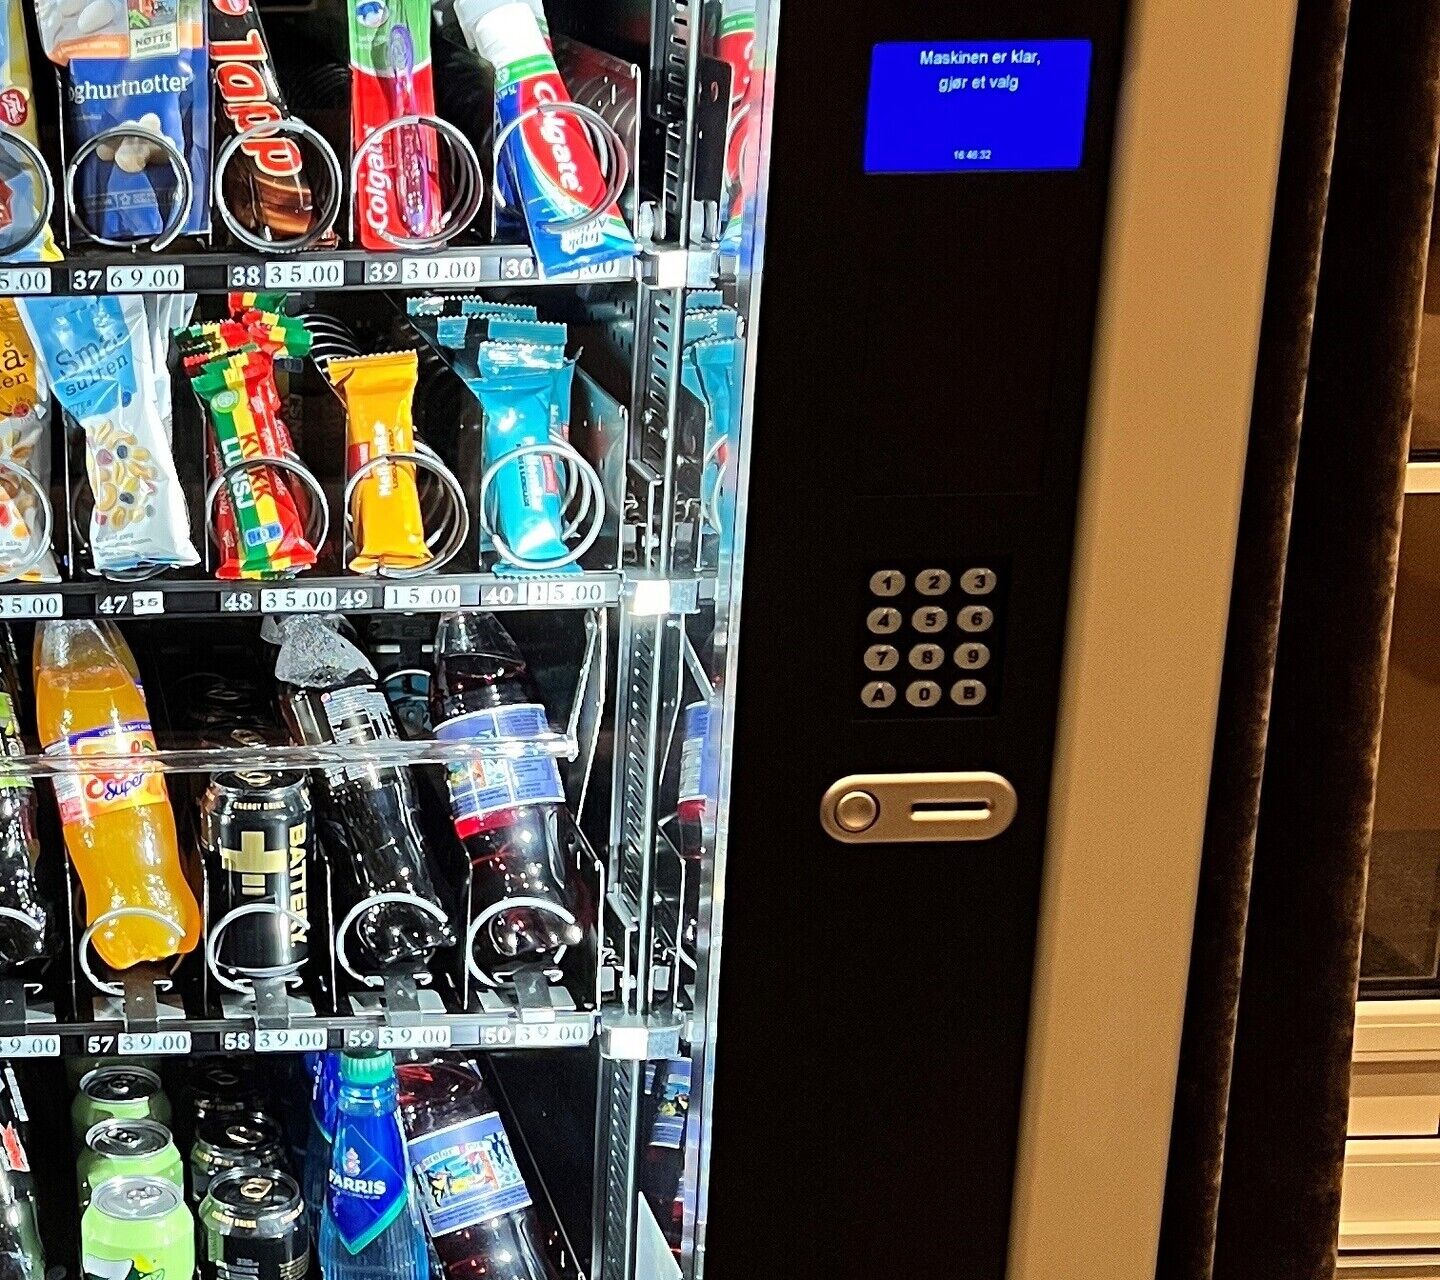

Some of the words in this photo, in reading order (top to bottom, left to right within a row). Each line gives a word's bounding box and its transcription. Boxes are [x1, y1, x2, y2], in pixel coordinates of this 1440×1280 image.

[920, 50, 989, 65] Maskinen
[992, 51, 1007, 64] er
[1011, 49, 1041, 66] klar,
[67, 72, 191, 104] oghurtnøtter
[939, 77, 968, 93] gjør
[971, 76, 986, 89] et
[989, 74, 1019, 92] valg
[232, 266, 261, 285] 38
[269, 264, 340, 283] 35.00
[369, 262, 398, 282] 39
[407, 262, 476, 280] 30.00
[505, 259, 534, 279] 30
[73, 270, 102, 290] 37
[110, 269, 180, 288] 69.00
[65, 354, 129, 396] sulten
[220, 436, 256, 510] LUNSJ
[882, 577, 892, 589] 1
[928, 576, 940, 589] 2
[974, 575, 986, 588] 3
[225, 592, 254, 611] 48
[266, 590, 333, 609] 35.00
[340, 589, 369, 607] 49
[391, 588, 457, 605] 15.00
[486, 585, 514, 604] 40
[99, 595, 128, 614] 47
[134, 597, 159, 608] 35
[877, 614, 889, 627] 4
[924, 614, 937, 627] 5
[971, 612, 983, 625] 6
[876, 651, 888, 665] 7
[922, 651, 933, 664] 8
[967, 650, 979, 663] 9
[872, 688, 885, 702] A
[919, 687, 930, 701] 0
[963, 686, 976, 699] B
[104, 771, 146, 801] Super
[288, 822, 308, 947] BATTERY
[88, 1036, 114, 1053] 57
[122, 1034, 187, 1051] 39.00
[224, 1033, 251, 1050] 58
[259, 1031, 324, 1048] 39.00
[348, 1030, 374, 1047] 59
[382, 1028, 447, 1045] 39.00
[484, 1027, 511, 1044] 50
[519, 1025, 584, 1042] 39.00
[328, 1169, 388, 1195] FARRIS
